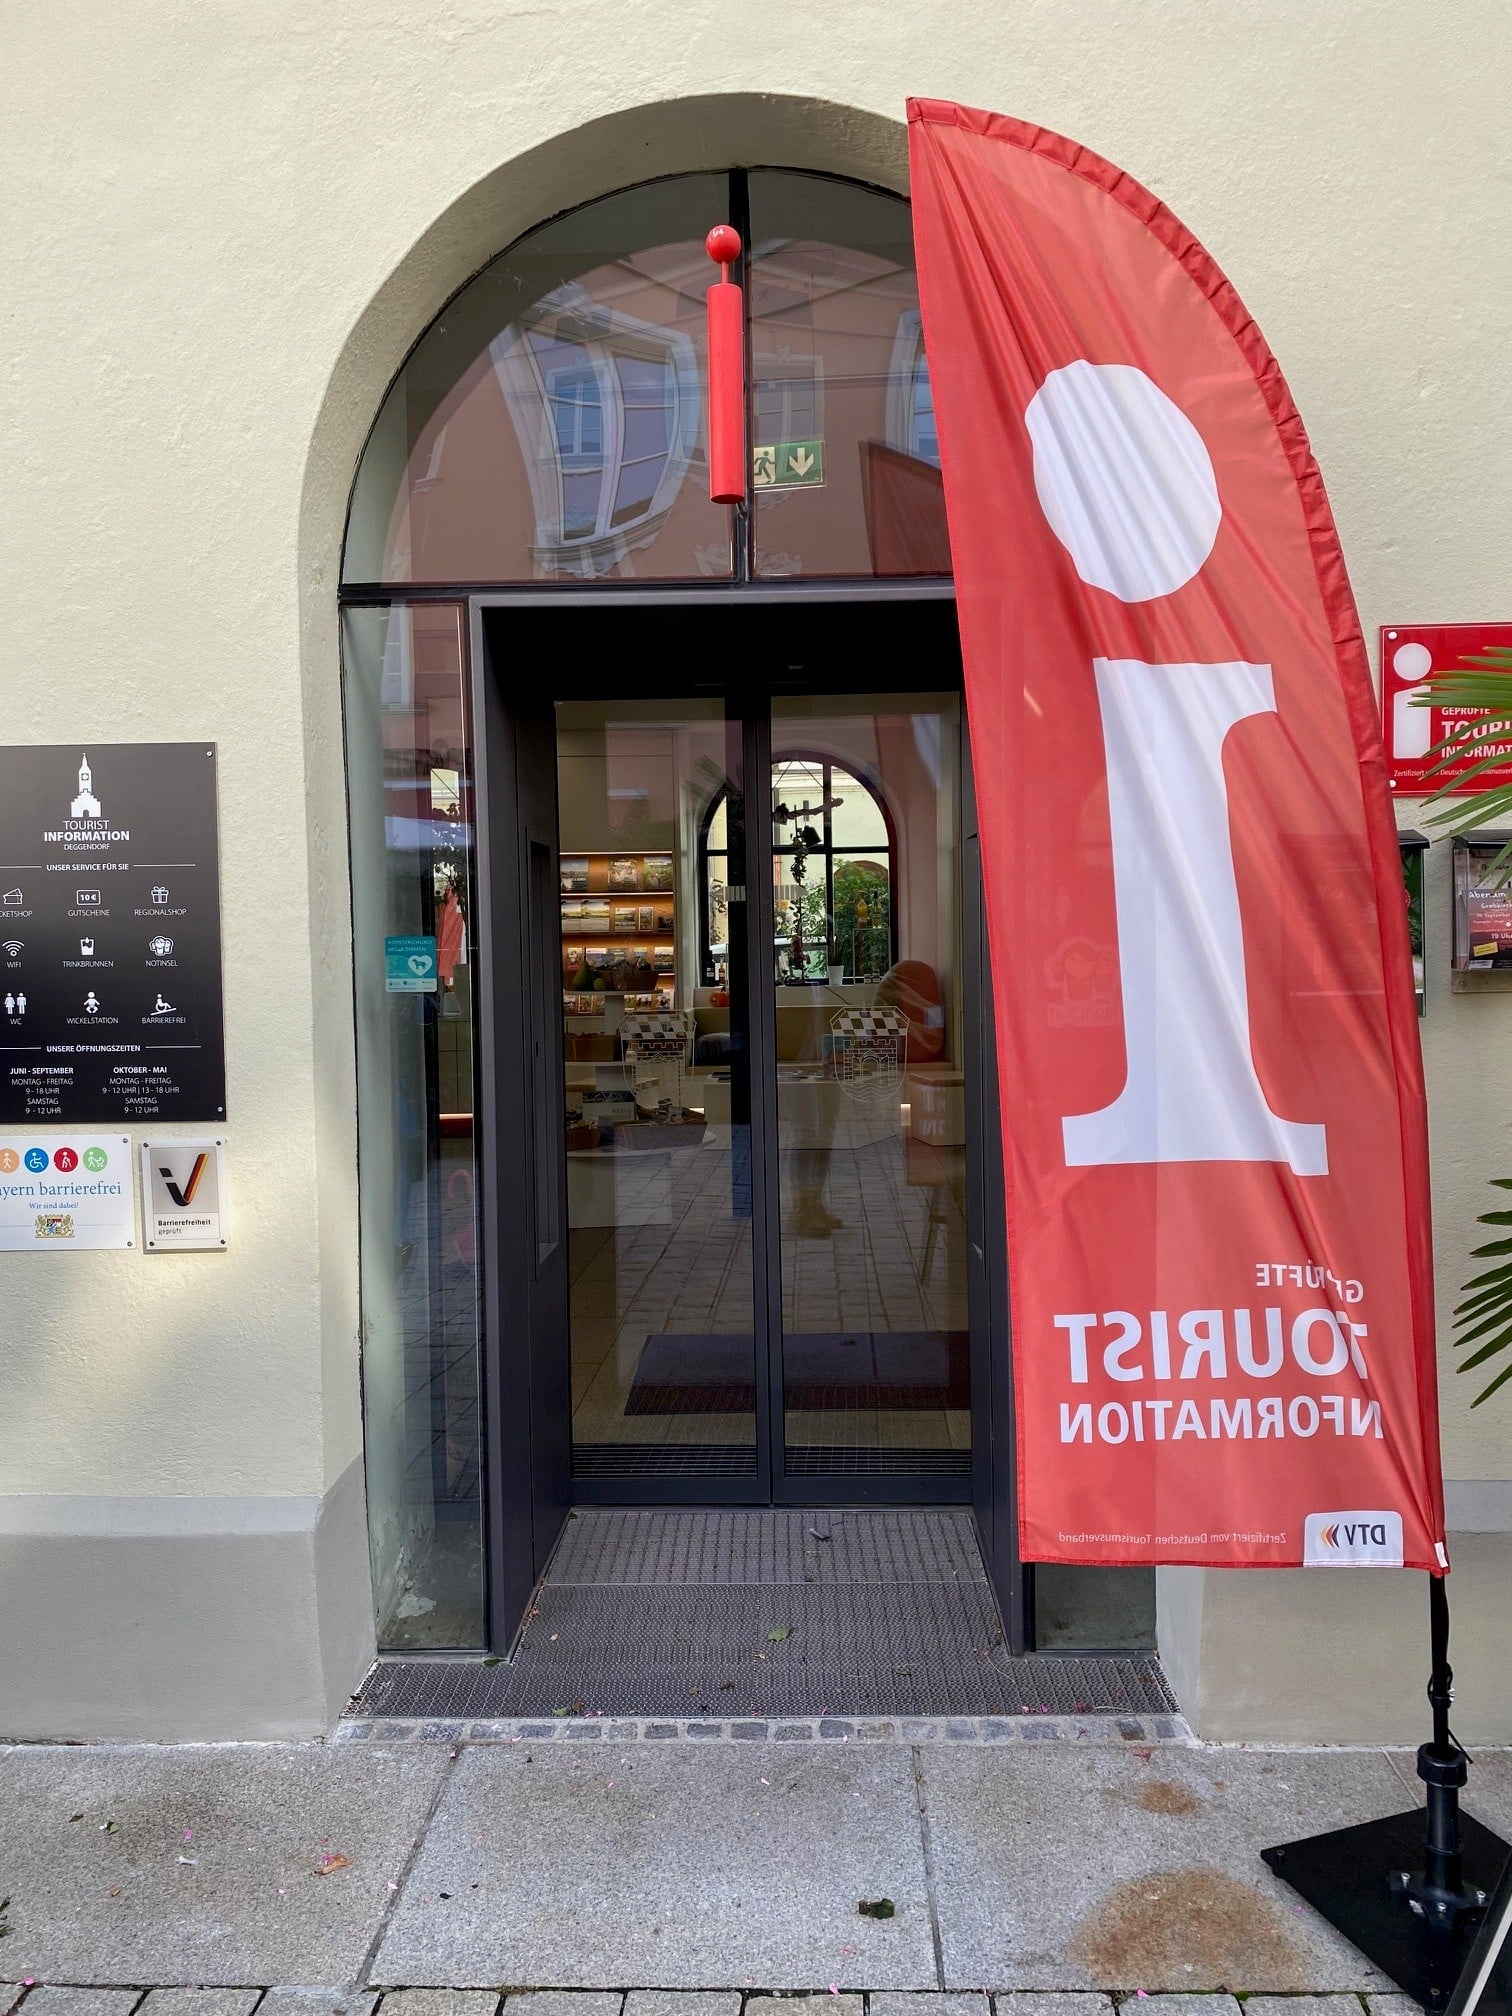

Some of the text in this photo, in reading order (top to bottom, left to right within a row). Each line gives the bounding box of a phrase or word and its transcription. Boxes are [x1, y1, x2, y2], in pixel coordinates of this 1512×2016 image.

[63, 820, 110, 830] TOURIST
[43, 831, 130, 842] INFORMATION
[64, 843, 110, 851] DEGGENDORF
[71, 863, 101, 871] SERVICE
[102, 862, 117, 871] FÜR
[68, 909, 110, 917] GUTSCHEINE
[134, 908, 187, 916] REGIONALSHOP
[62, 960, 114, 968] TRINKBRUNNEN
[75, 1044, 141, 1052] ÖFFNUNGSZEITEN
[10, 1067, 27, 1075] JUNI
[32, 1067, 74, 1075] SEPTEMBER
[113, 1066, 147, 1074] OKTOBER
[152, 1066, 168, 1074] MAI
[39, 1181, 122, 1196] barrierefrei
[158, 1227, 182, 1235] geprüft
